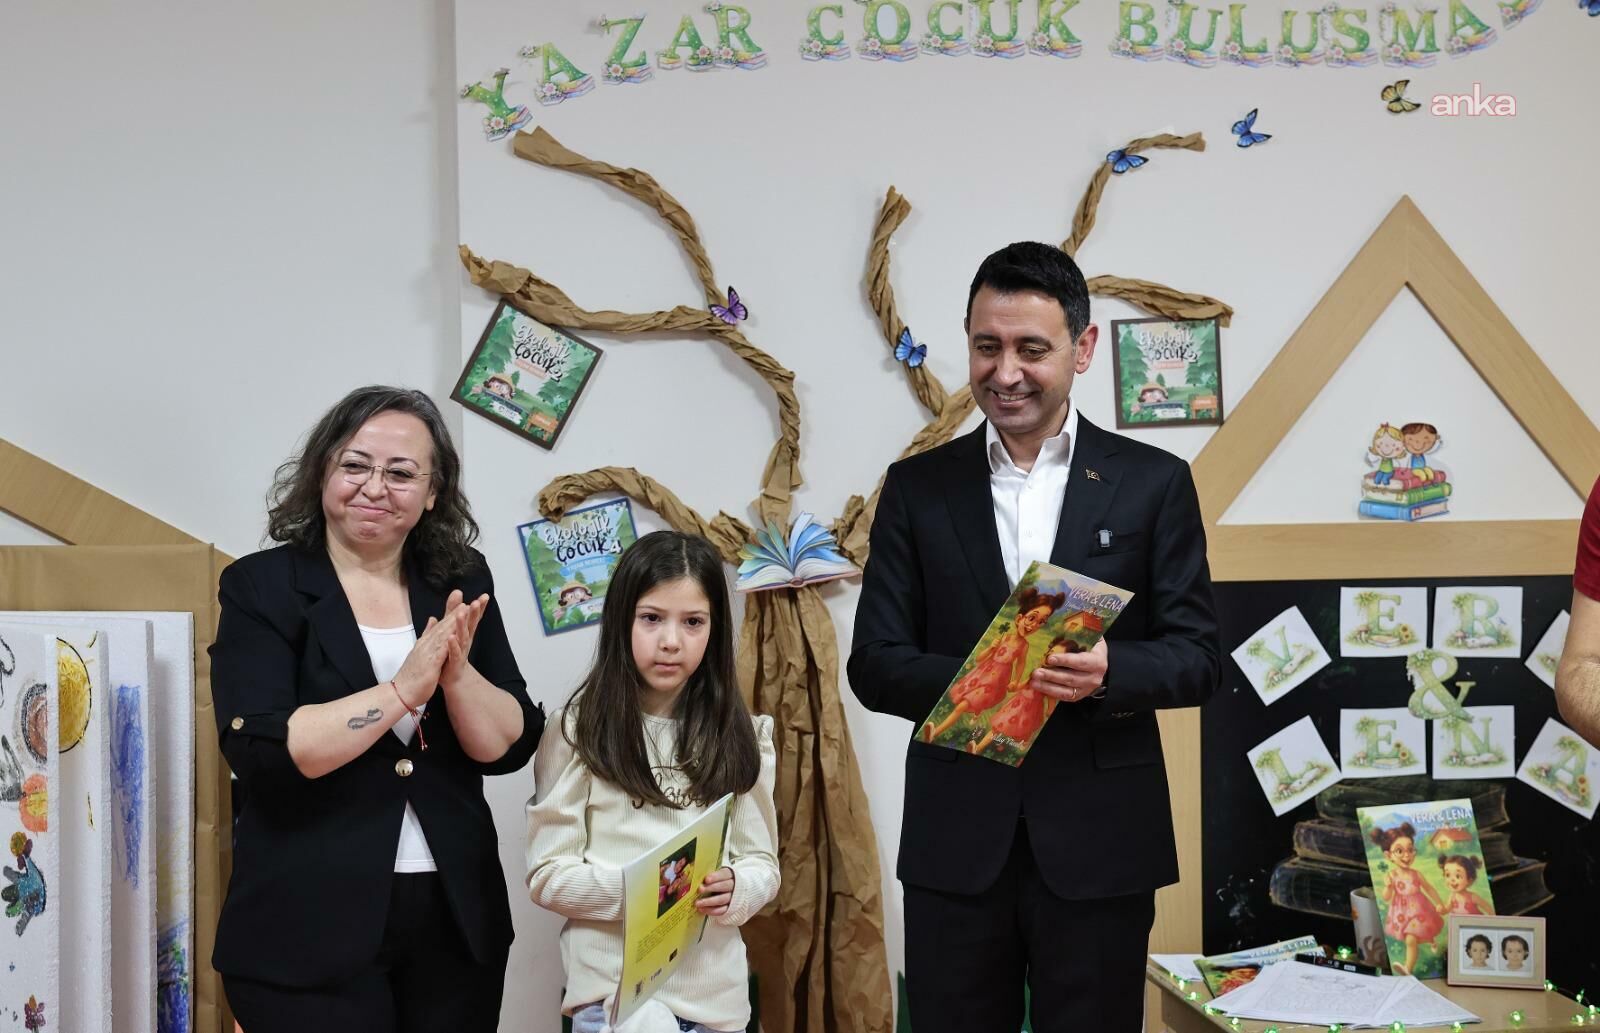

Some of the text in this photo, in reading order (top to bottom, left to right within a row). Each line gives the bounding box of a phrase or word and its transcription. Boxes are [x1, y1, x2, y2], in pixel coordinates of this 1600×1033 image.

[461, 4, 766, 132] YAZAR
[1069, 585, 1094, 603] VERA
[1099, 596, 1125, 612] LENA
[1406, 648, 1477, 722] &
[1410, 812, 1436, 824] VERA
[1446, 808, 1473, 820] LENA
